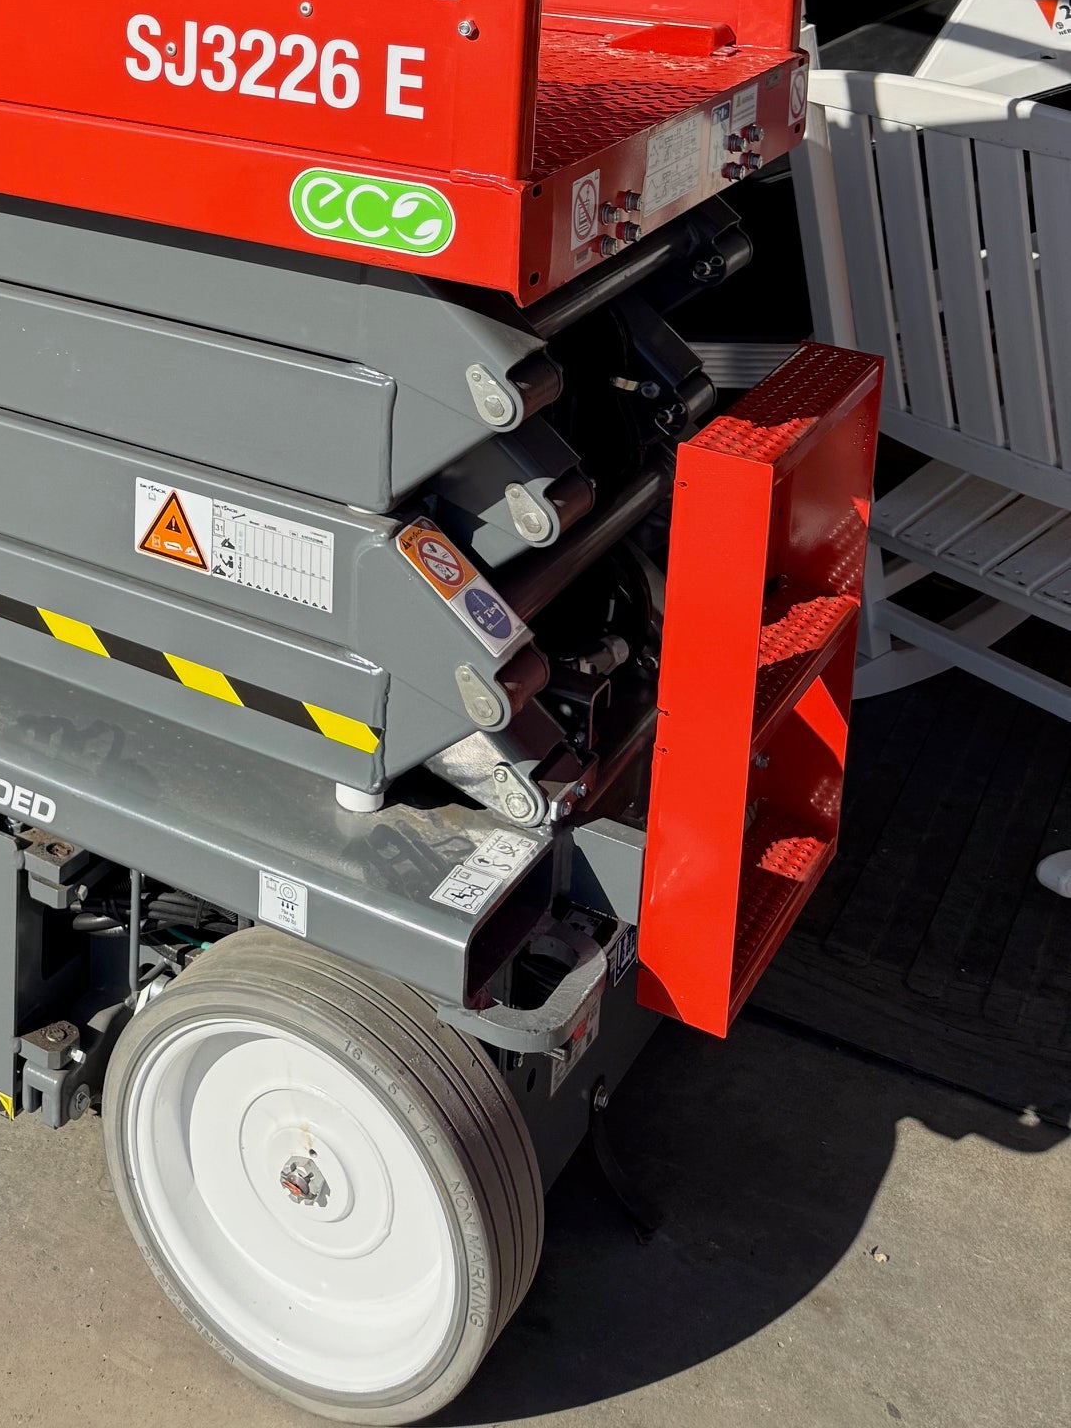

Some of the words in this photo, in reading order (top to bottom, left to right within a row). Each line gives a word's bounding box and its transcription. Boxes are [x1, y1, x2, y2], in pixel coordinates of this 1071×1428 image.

[125, 14, 360, 109] SJ3226
[385, 44, 426, 120] E
[301, 177, 443, 246] eco
[344, 1039, 363, 1061] 16
[387, 1081, 400, 1095] 5
[418, 1123, 438, 1147] 12
[449, 1180, 476, 1224] NON
[465, 1233, 486, 1328] MARKING
